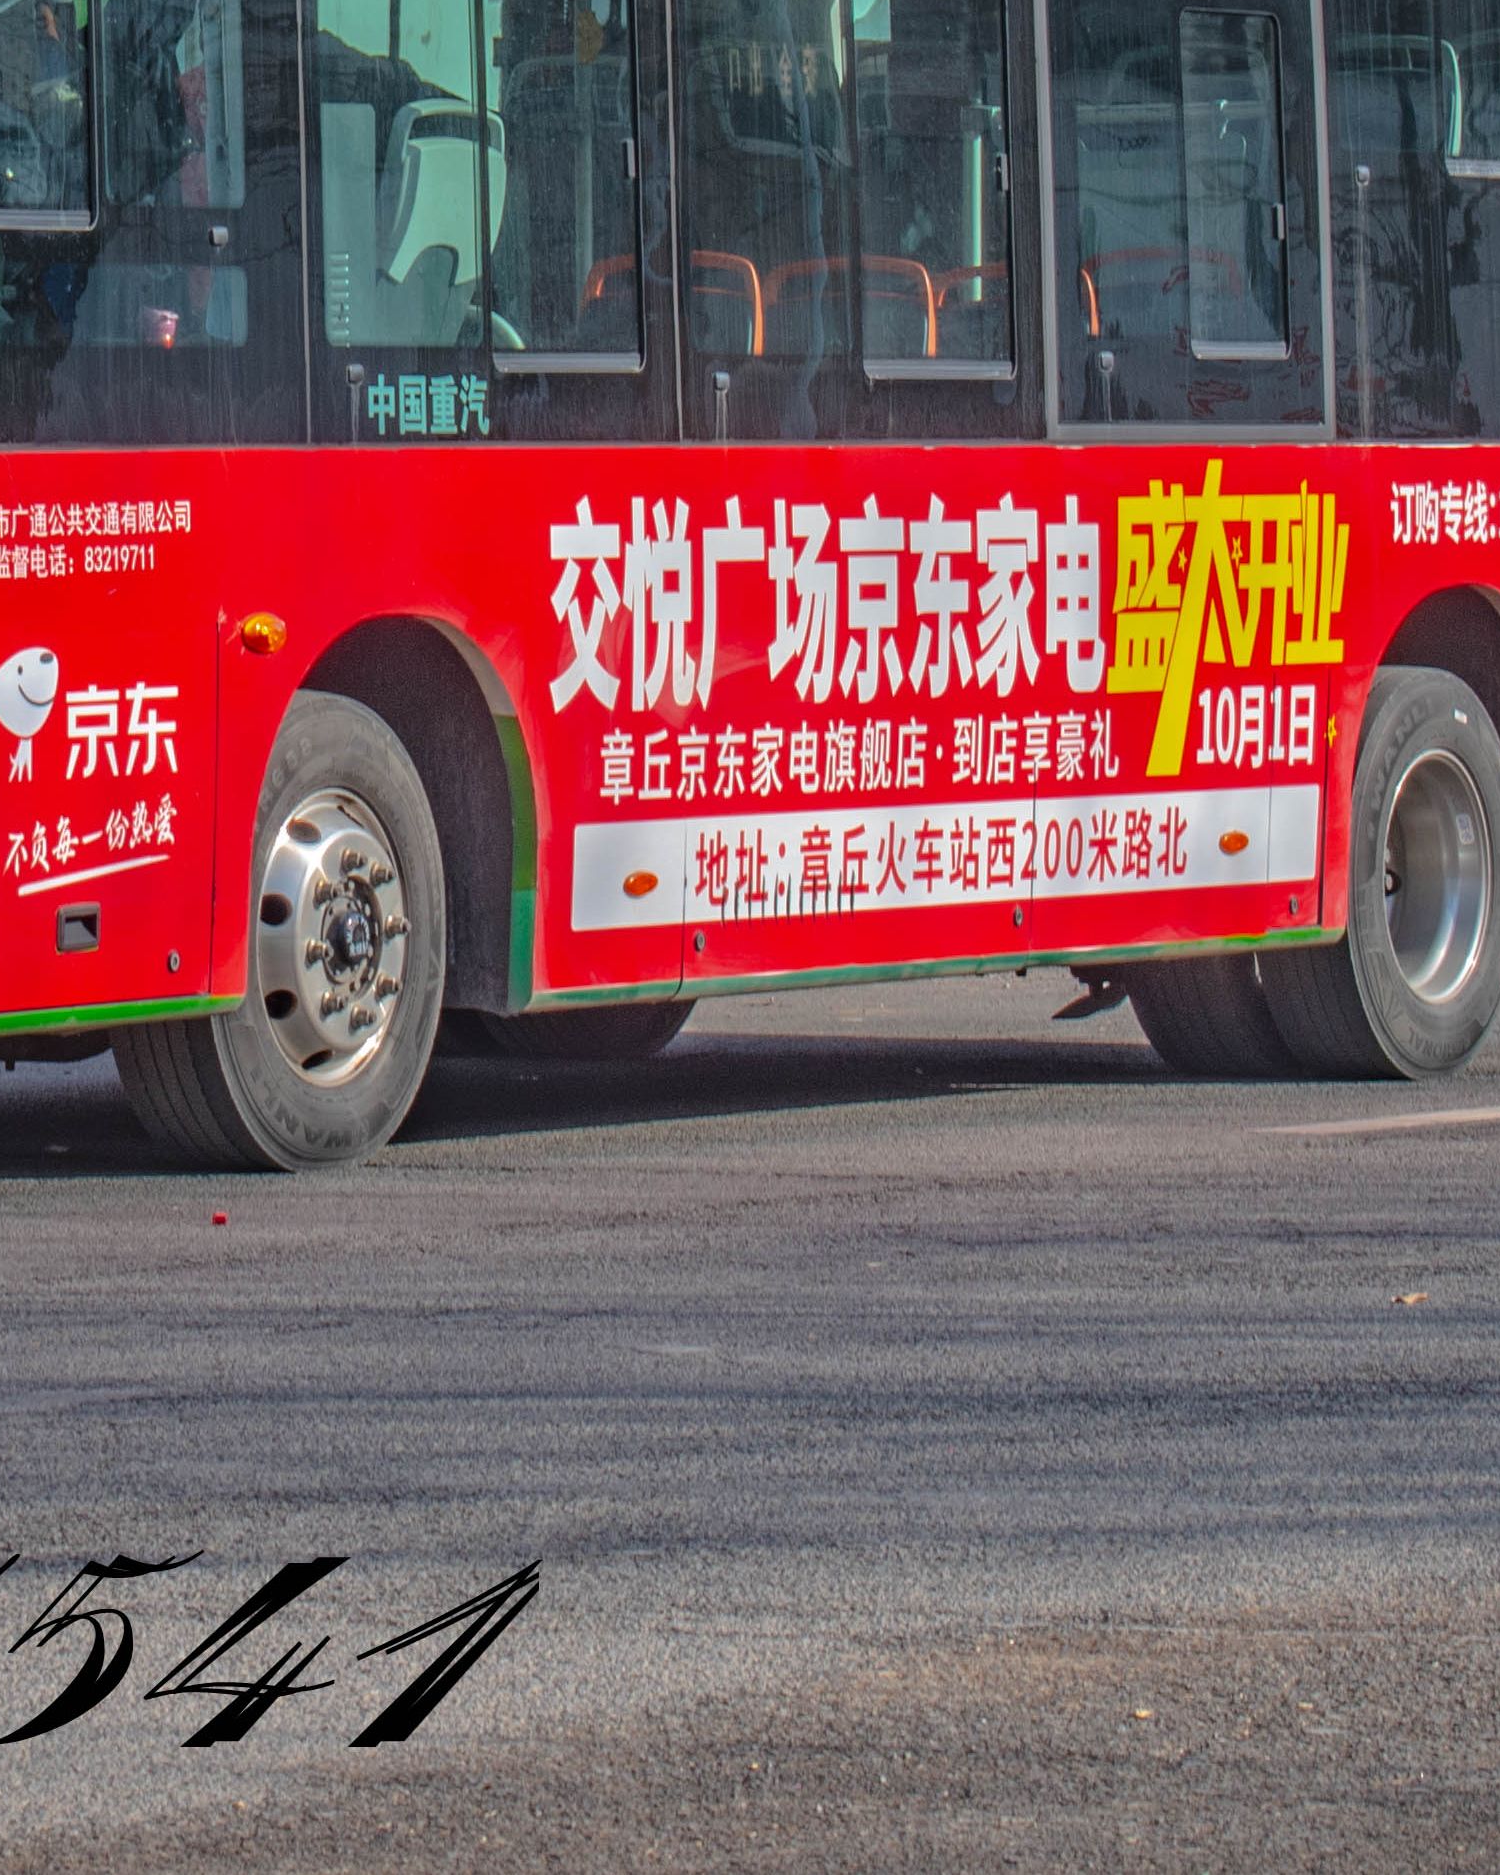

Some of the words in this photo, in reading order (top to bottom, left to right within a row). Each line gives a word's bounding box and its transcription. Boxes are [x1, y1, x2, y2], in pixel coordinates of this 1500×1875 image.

[368, 374, 490, 435] 中国重汽
[549, 492, 1106, 714] 交悦广场京东家电
[1106, 458, 1350, 778] 盛大开业
[65, 681, 180, 780] 京东
[1195, 684, 1317, 770] 10月1日
[2, 793, 179, 879] 不负每一份热爱
